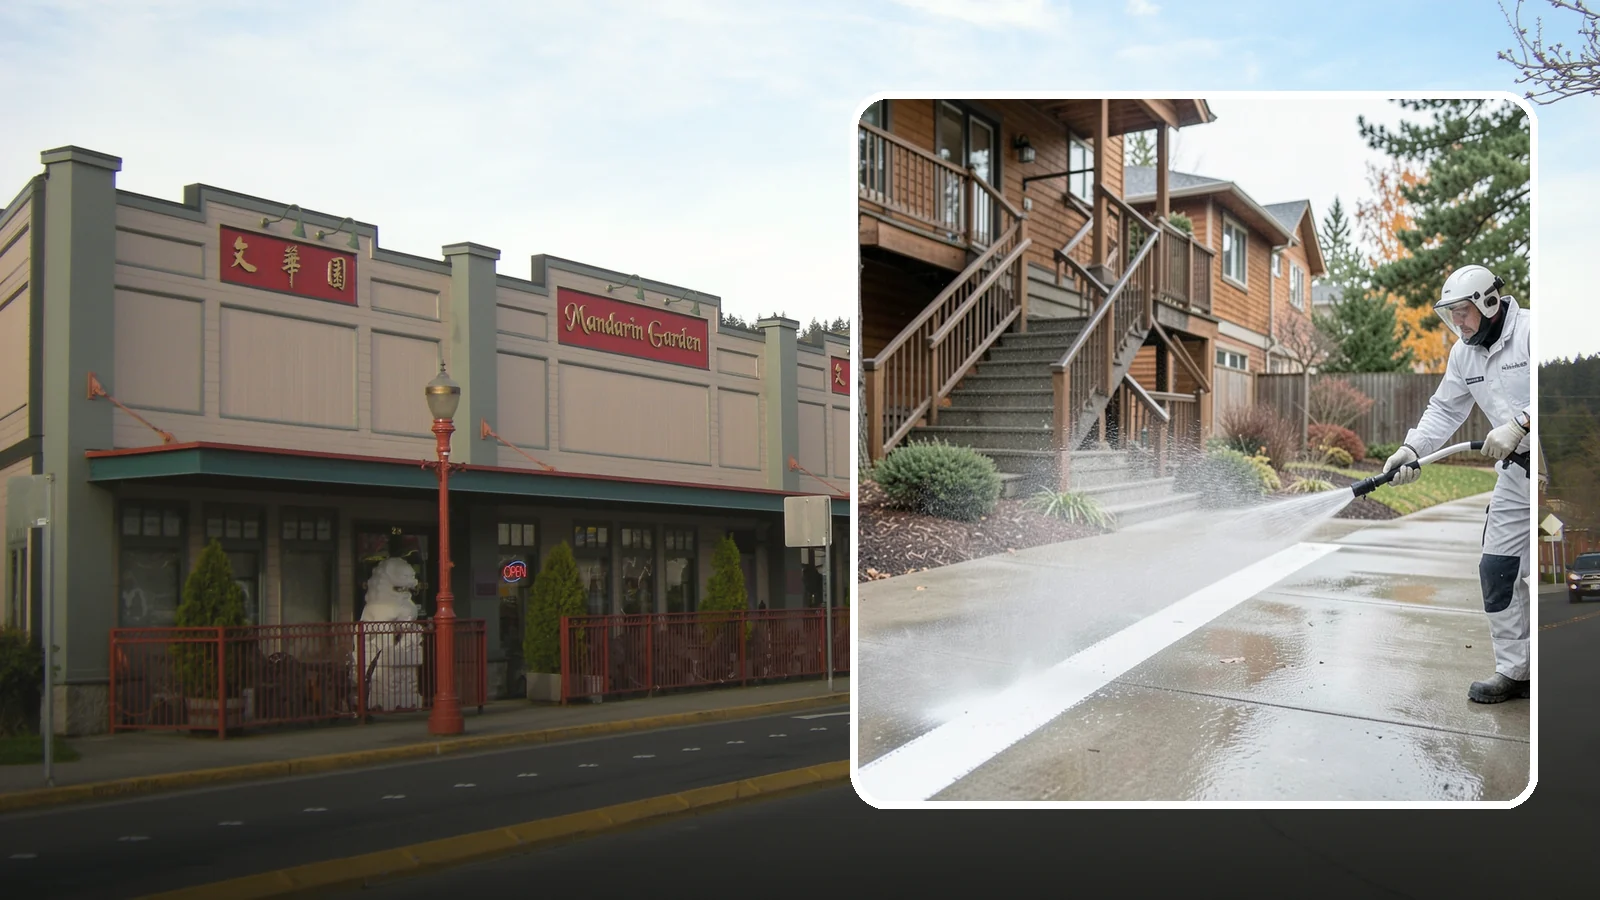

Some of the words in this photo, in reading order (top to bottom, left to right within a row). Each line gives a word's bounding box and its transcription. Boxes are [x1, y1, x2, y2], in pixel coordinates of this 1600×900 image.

[231, 235, 346, 291] 文華園
[564, 302, 643, 341] Mandarin
[648, 320, 701, 352] Garden
[503, 565, 527, 578] OPEN
